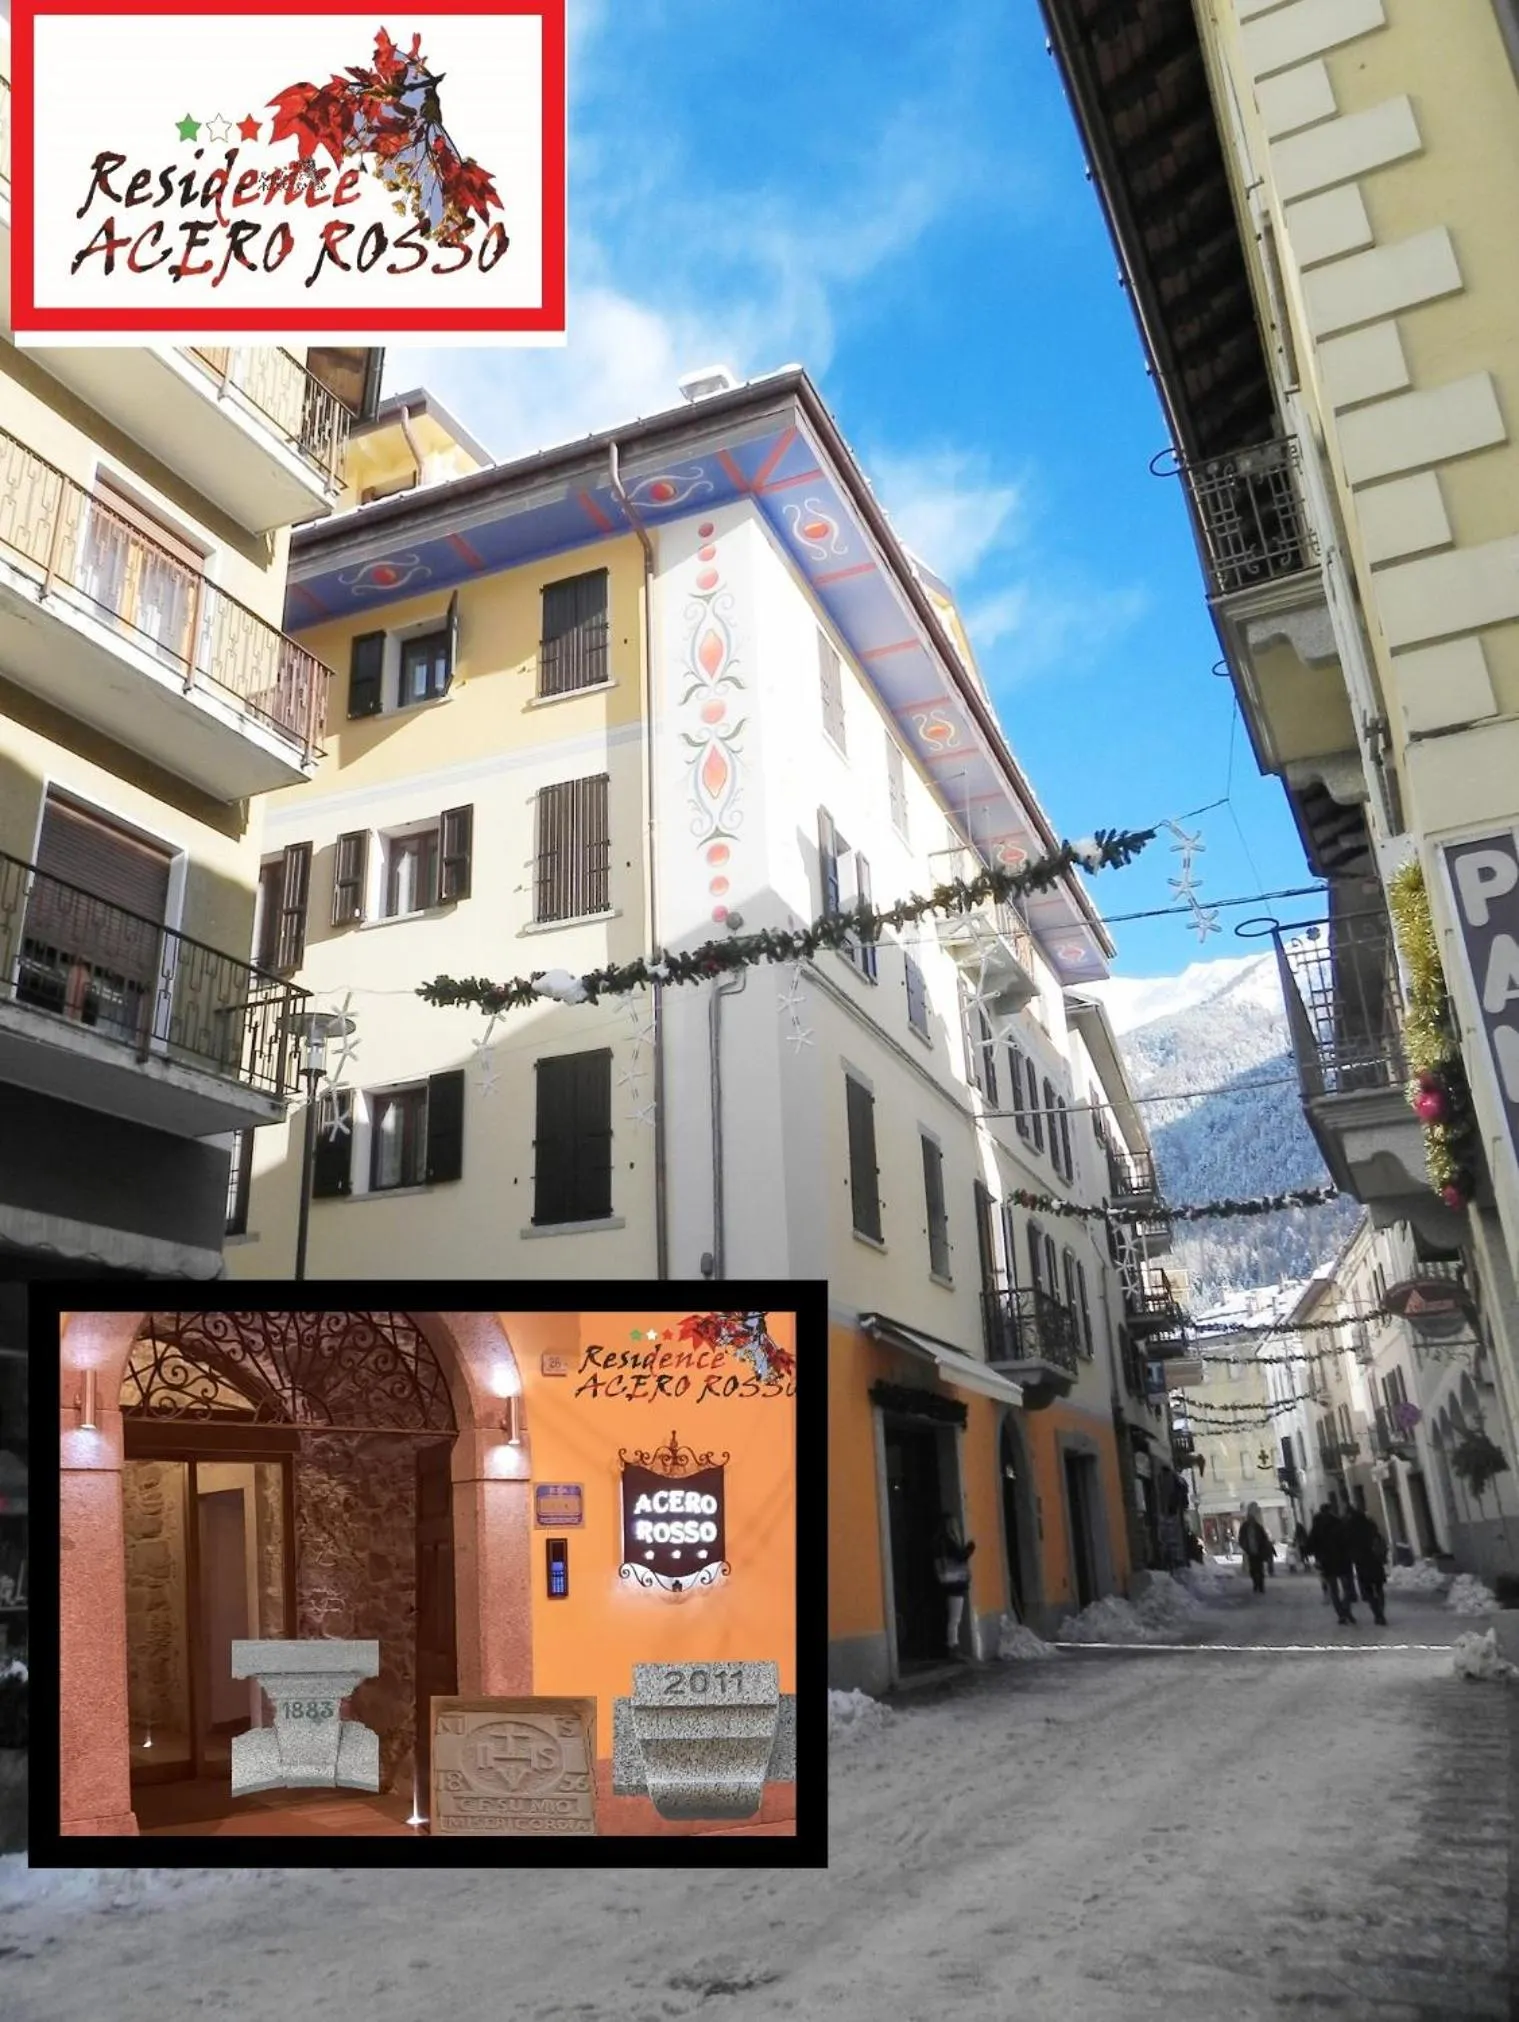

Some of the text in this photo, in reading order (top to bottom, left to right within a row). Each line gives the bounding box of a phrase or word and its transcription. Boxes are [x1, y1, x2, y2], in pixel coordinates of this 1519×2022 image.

[633, 1489, 718, 1515] ACERO
[634, 1519, 718, 1545] ROSSO
[663, 1669, 743, 1695] 2011
[283, 1701, 334, 1720] 1883
